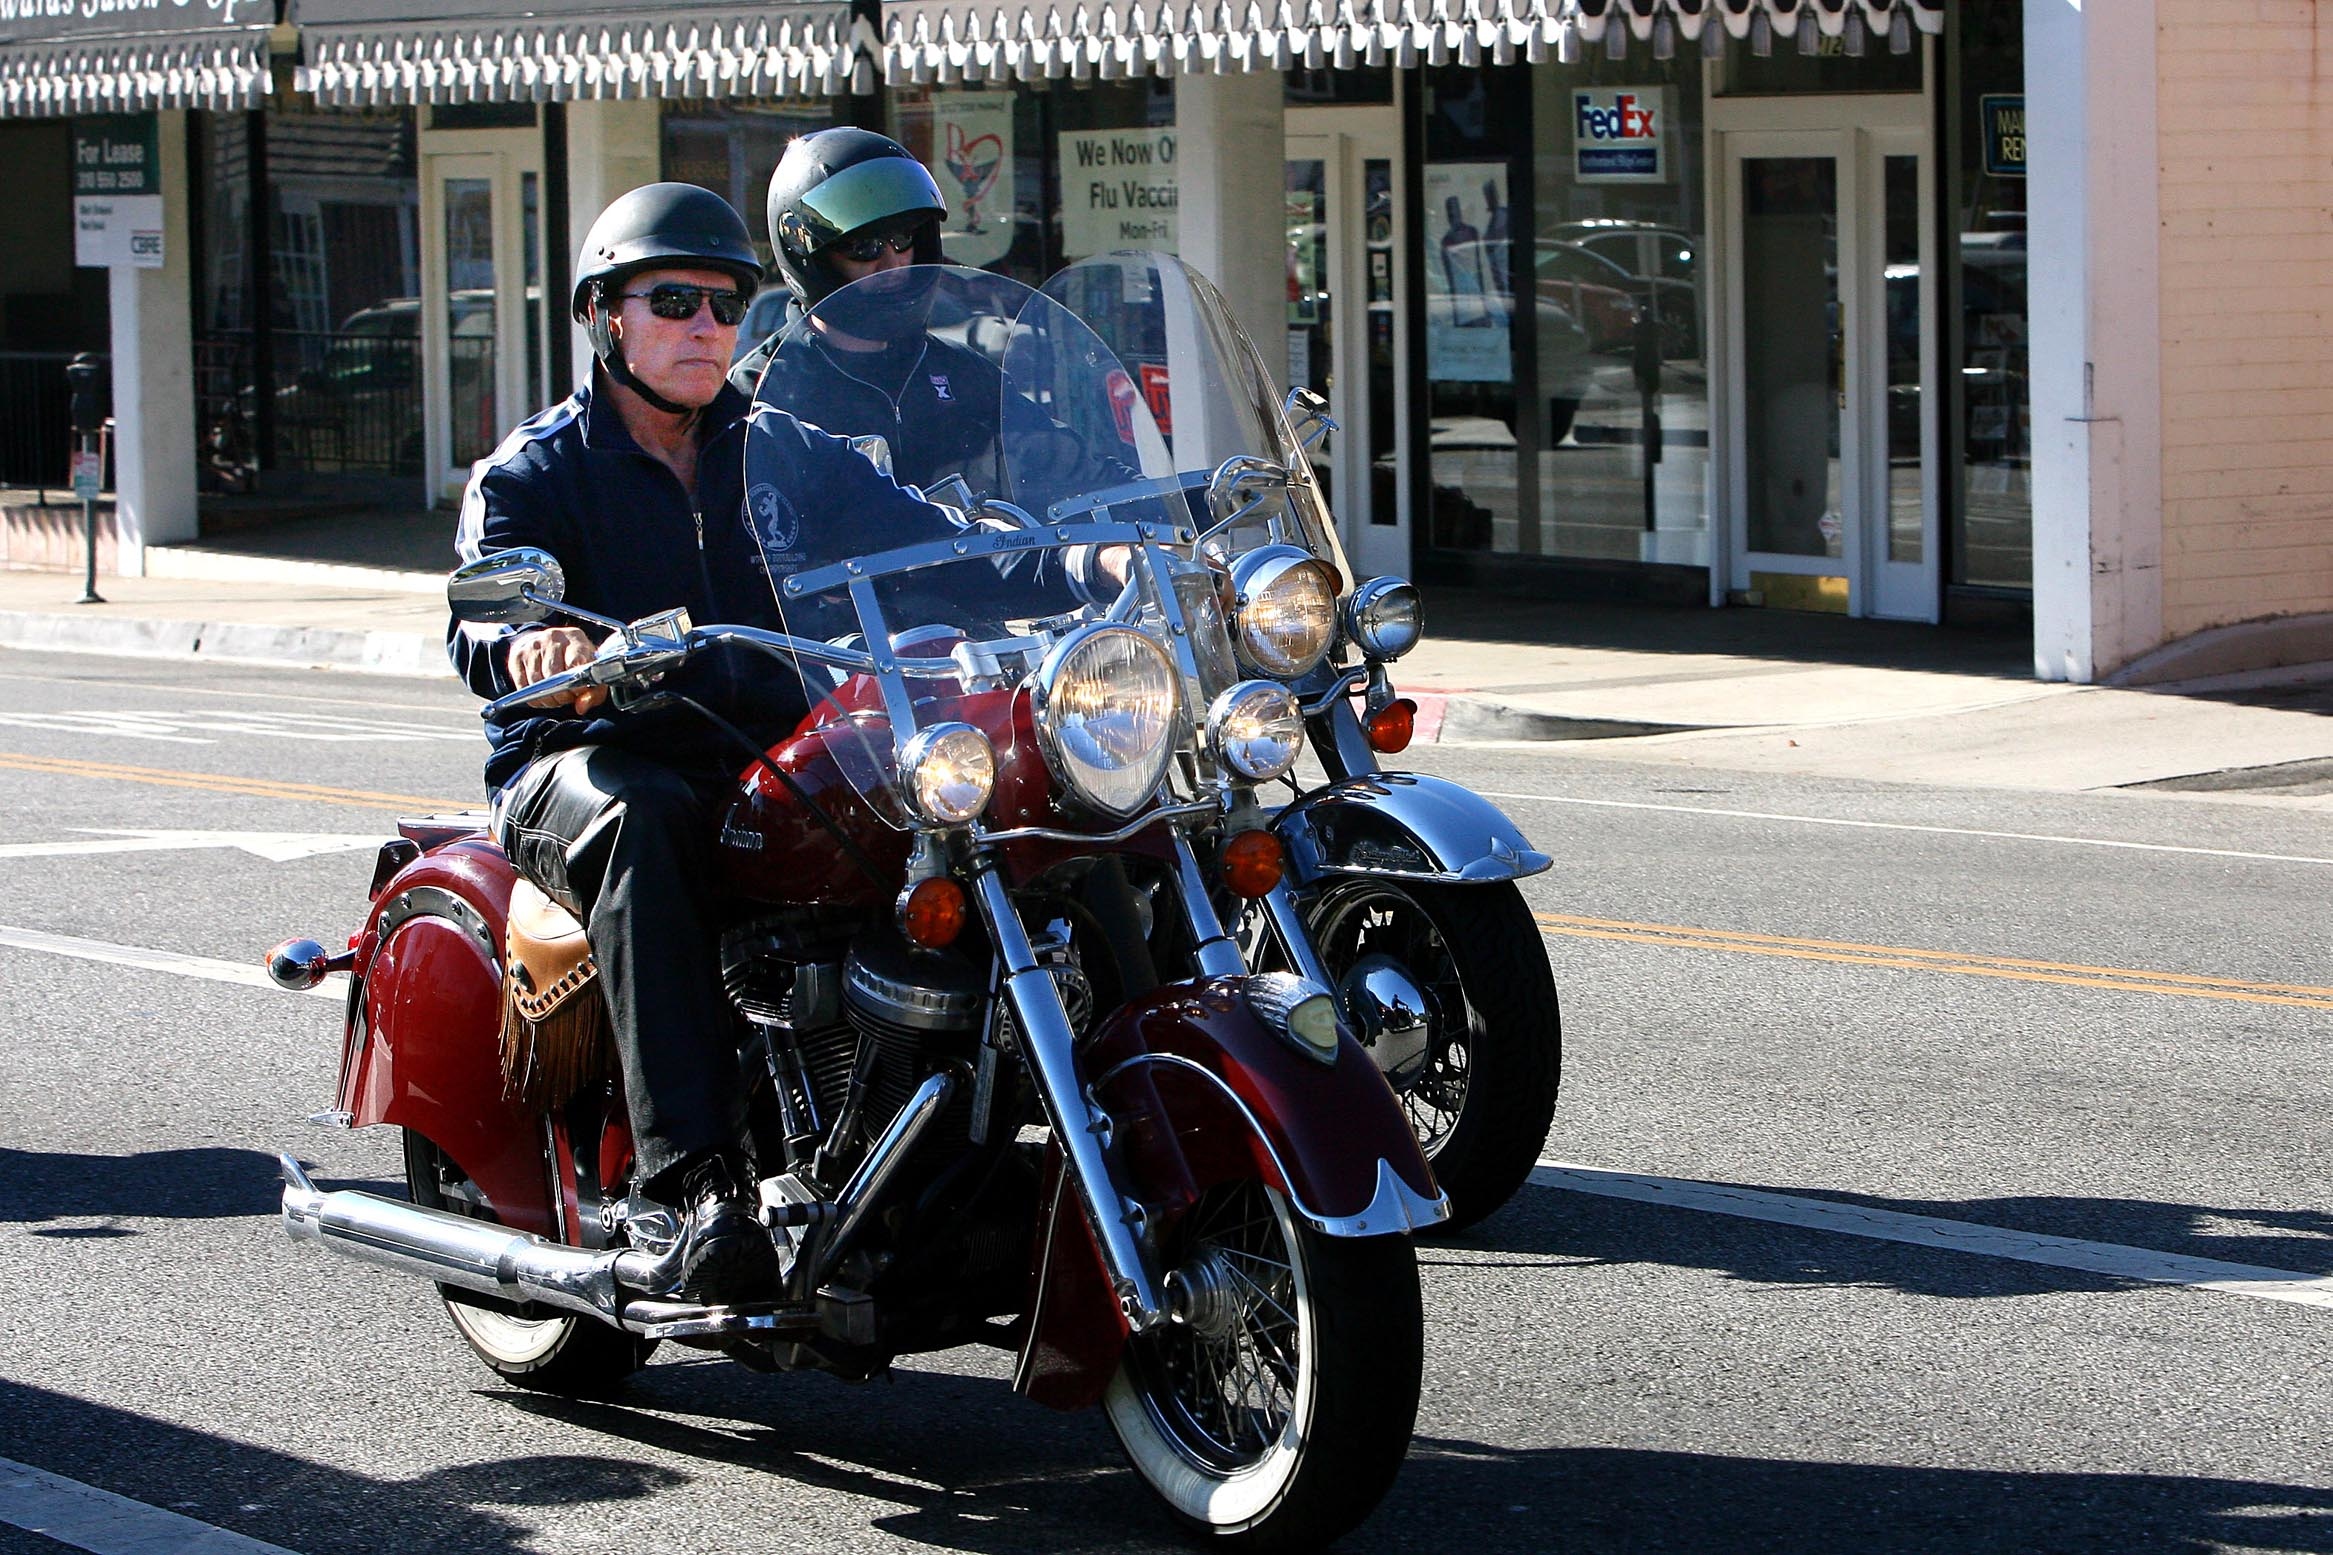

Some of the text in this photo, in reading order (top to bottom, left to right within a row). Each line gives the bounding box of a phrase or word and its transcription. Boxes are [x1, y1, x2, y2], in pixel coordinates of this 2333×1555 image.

[1576, 94, 1656, 139] FedEx
[77, 138, 144, 164] For Lease
[1076, 135, 1177, 166] We Now O
[1090, 181, 1118, 209] Flu
[131, 236, 160, 254] CBRE
[993, 534, 1035, 549] Indian
